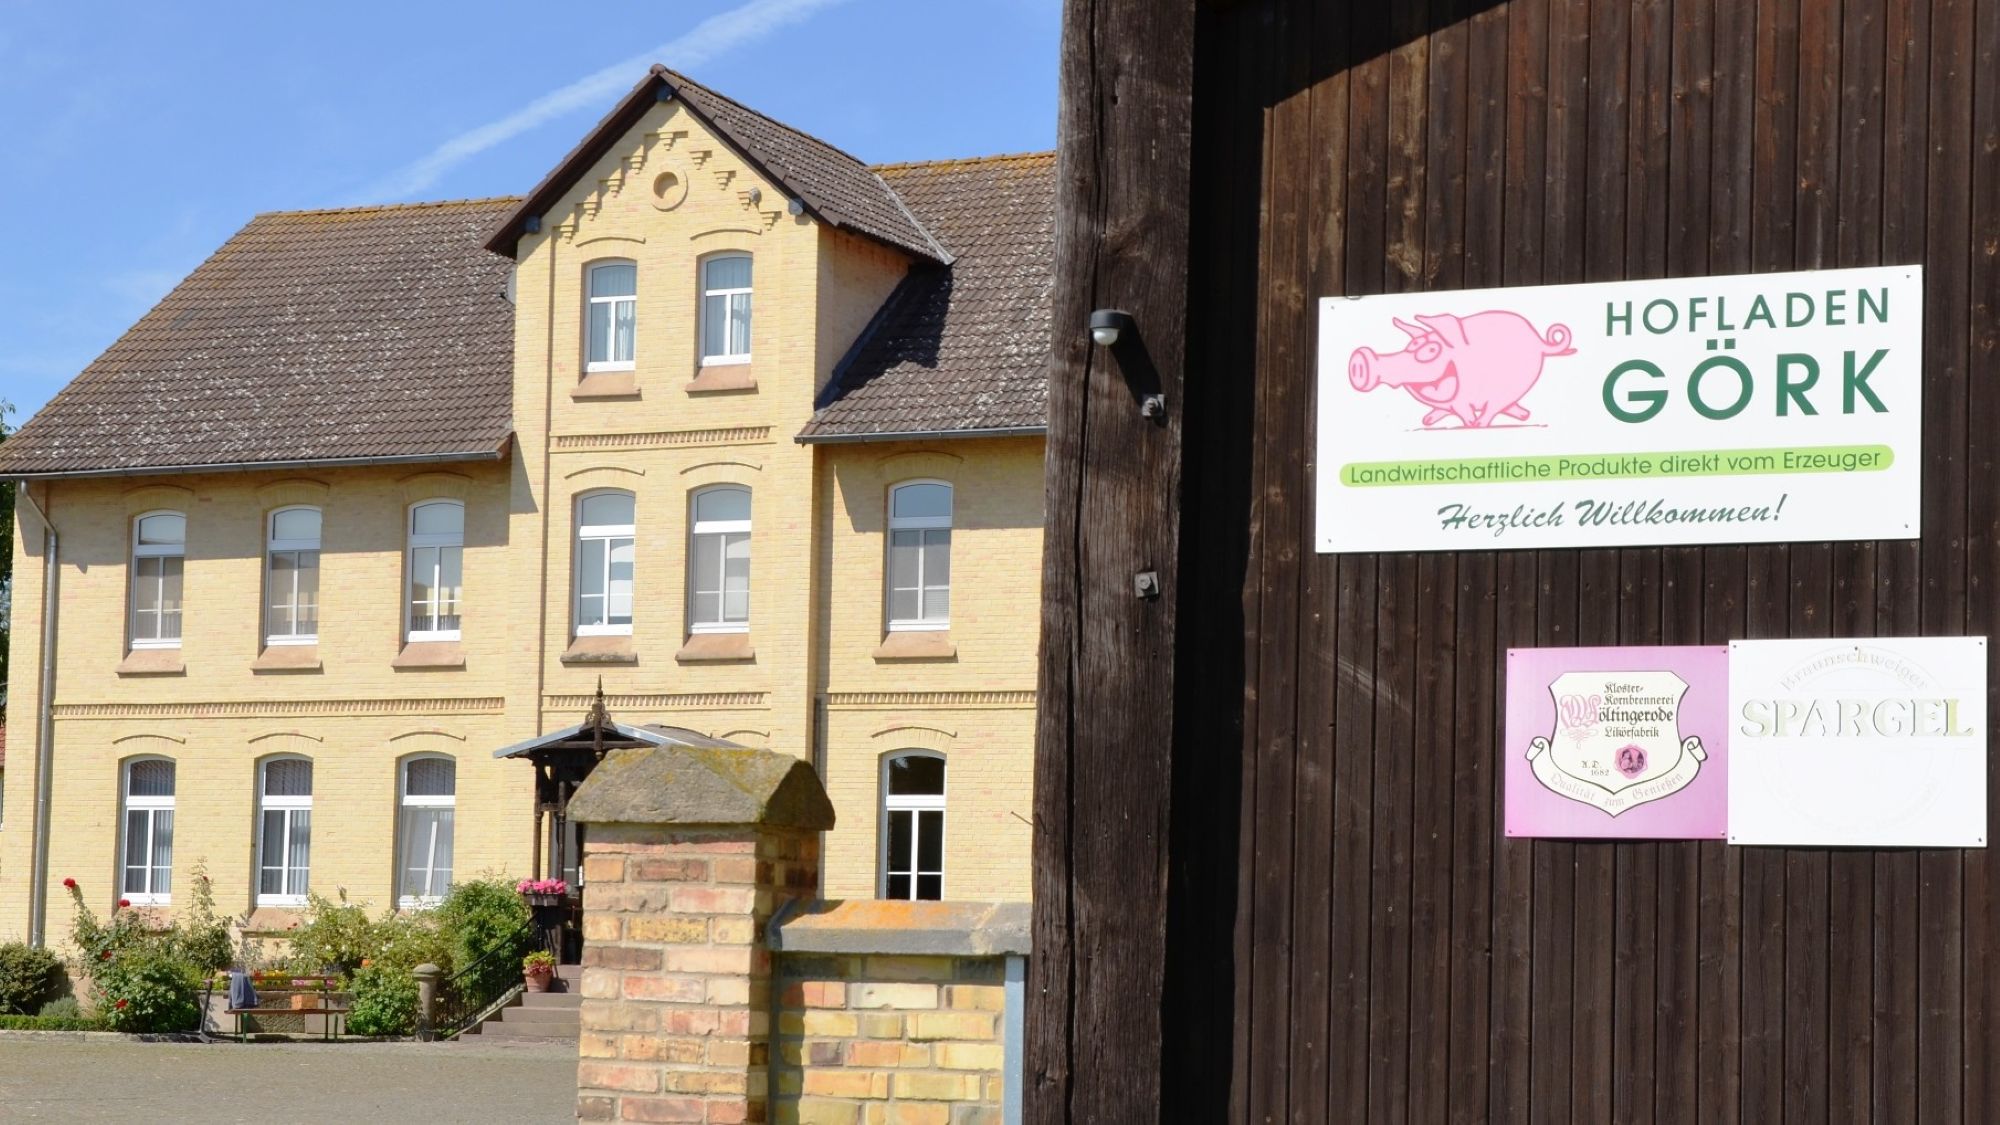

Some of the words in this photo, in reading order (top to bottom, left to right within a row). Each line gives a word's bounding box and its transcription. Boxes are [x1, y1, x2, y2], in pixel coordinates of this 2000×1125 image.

[1605, 287, 1890, 337] HOFLADEN
[1602, 338, 1891, 424] GÖRK
[1350, 459, 1551, 485] Landwirtschaftliche
[1558, 455, 1652, 478] Produkte
[1659, 452, 1720, 475] direkt
[1726, 454, 1775, 472] vom
[1783, 449, 1881, 473] Erzeuger
[1437, 500, 1564, 537] Herzlich
[1574, 493, 1788, 527] Willkommen!
[1740, 698, 1974, 738] SPARGEL
